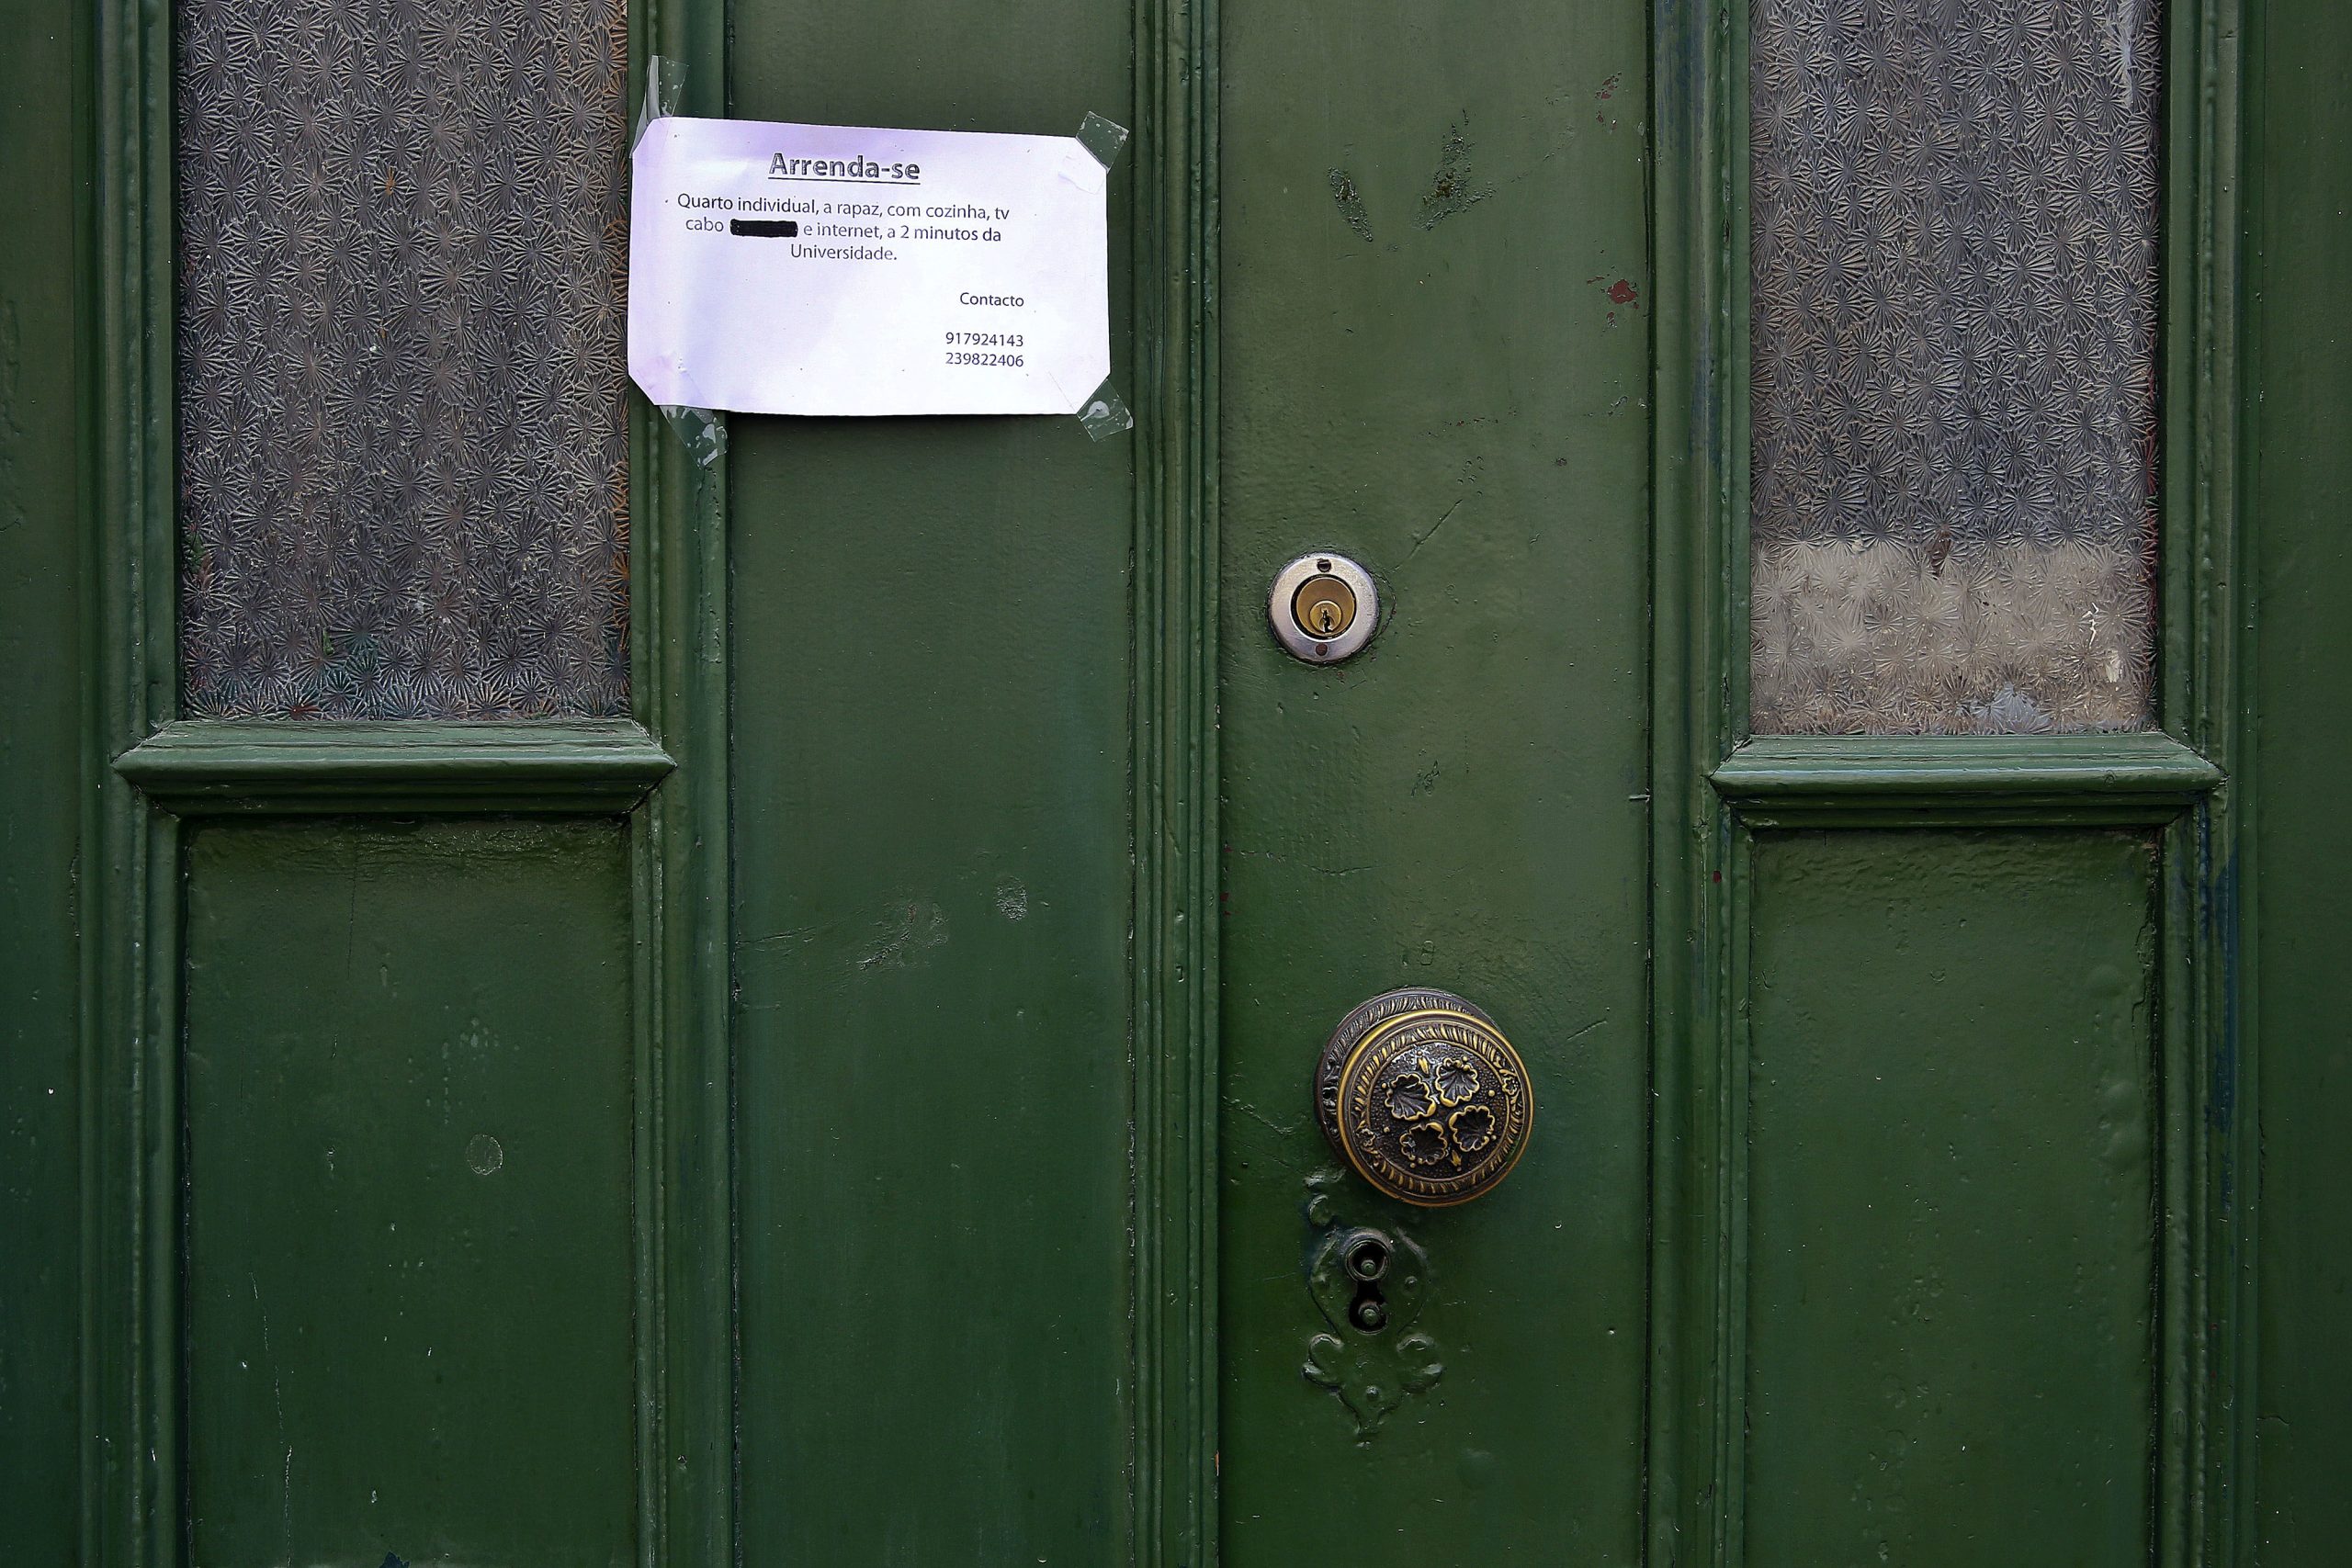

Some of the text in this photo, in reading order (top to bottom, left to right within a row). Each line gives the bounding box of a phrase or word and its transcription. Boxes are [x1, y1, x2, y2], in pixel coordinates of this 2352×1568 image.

[768, 152, 921, 180] Arrenda-se
[678, 193, 1010, 220] Quarto individual, a rapaz, com cozinha, tv
[685, 217, 724, 231] cabo
[804, 226, 812, 235] e
[818, 222, 883, 240] internet,
[888, 229, 896, 238] a
[900, 225, 910, 239] 2
[914, 226, 978, 241] minutos
[983, 228, 1001, 242] da
[791, 243, 898, 260] Universidade.
[960, 292, 1024, 307] Contacto
[945, 332, 1023, 346] 917924143
[945, 352, 1023, 367] 239822406
